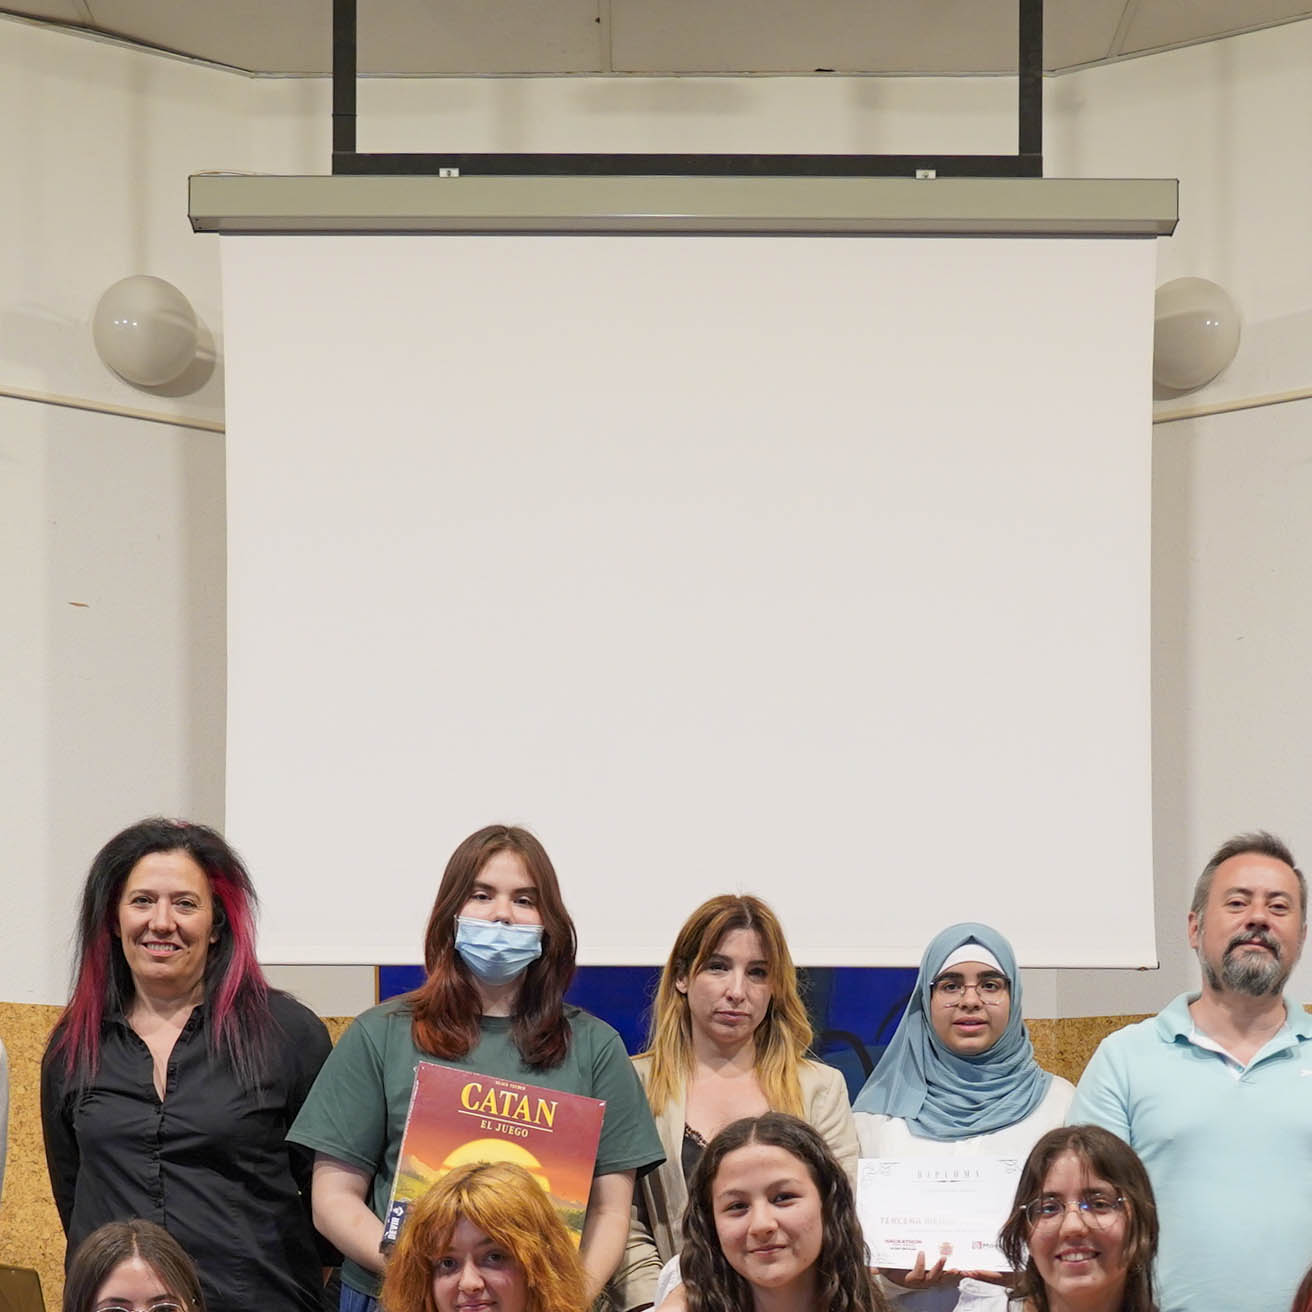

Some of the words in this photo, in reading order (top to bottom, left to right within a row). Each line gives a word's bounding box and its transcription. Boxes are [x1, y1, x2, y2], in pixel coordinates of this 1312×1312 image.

[461, 1082, 559, 1127] CATAN
[480, 1120, 493, 1130] EL
[495, 1123, 529, 1138] JUEGO
